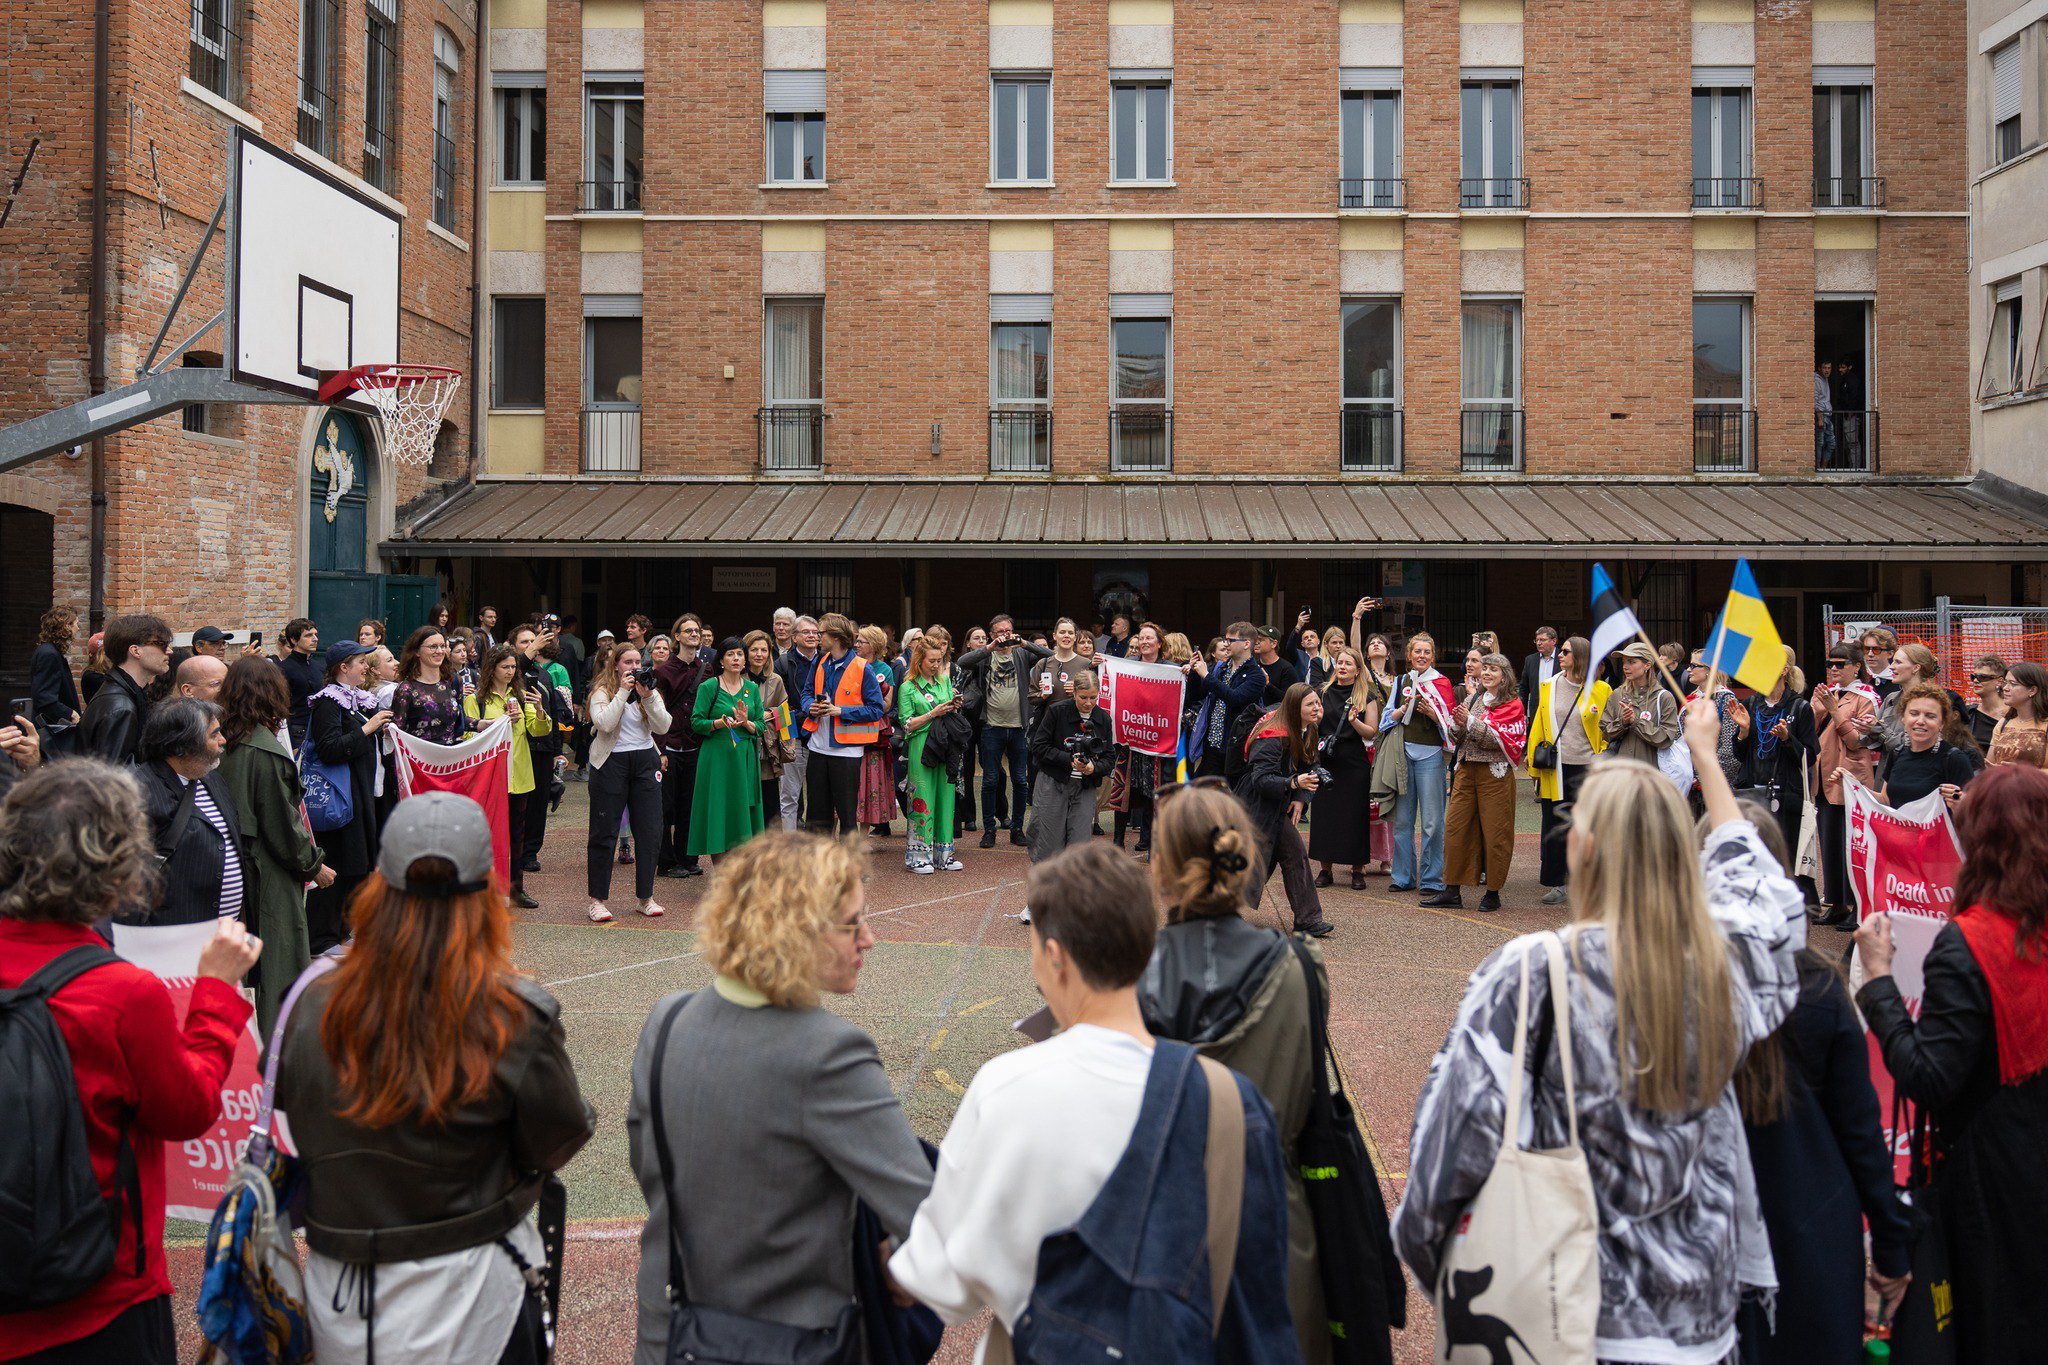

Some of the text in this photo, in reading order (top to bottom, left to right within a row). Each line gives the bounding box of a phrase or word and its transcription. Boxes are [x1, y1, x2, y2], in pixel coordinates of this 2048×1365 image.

[1122, 709, 1169, 728] Death in
[1122, 724, 1159, 742] Venice
[1886, 873, 1955, 904] Death in
